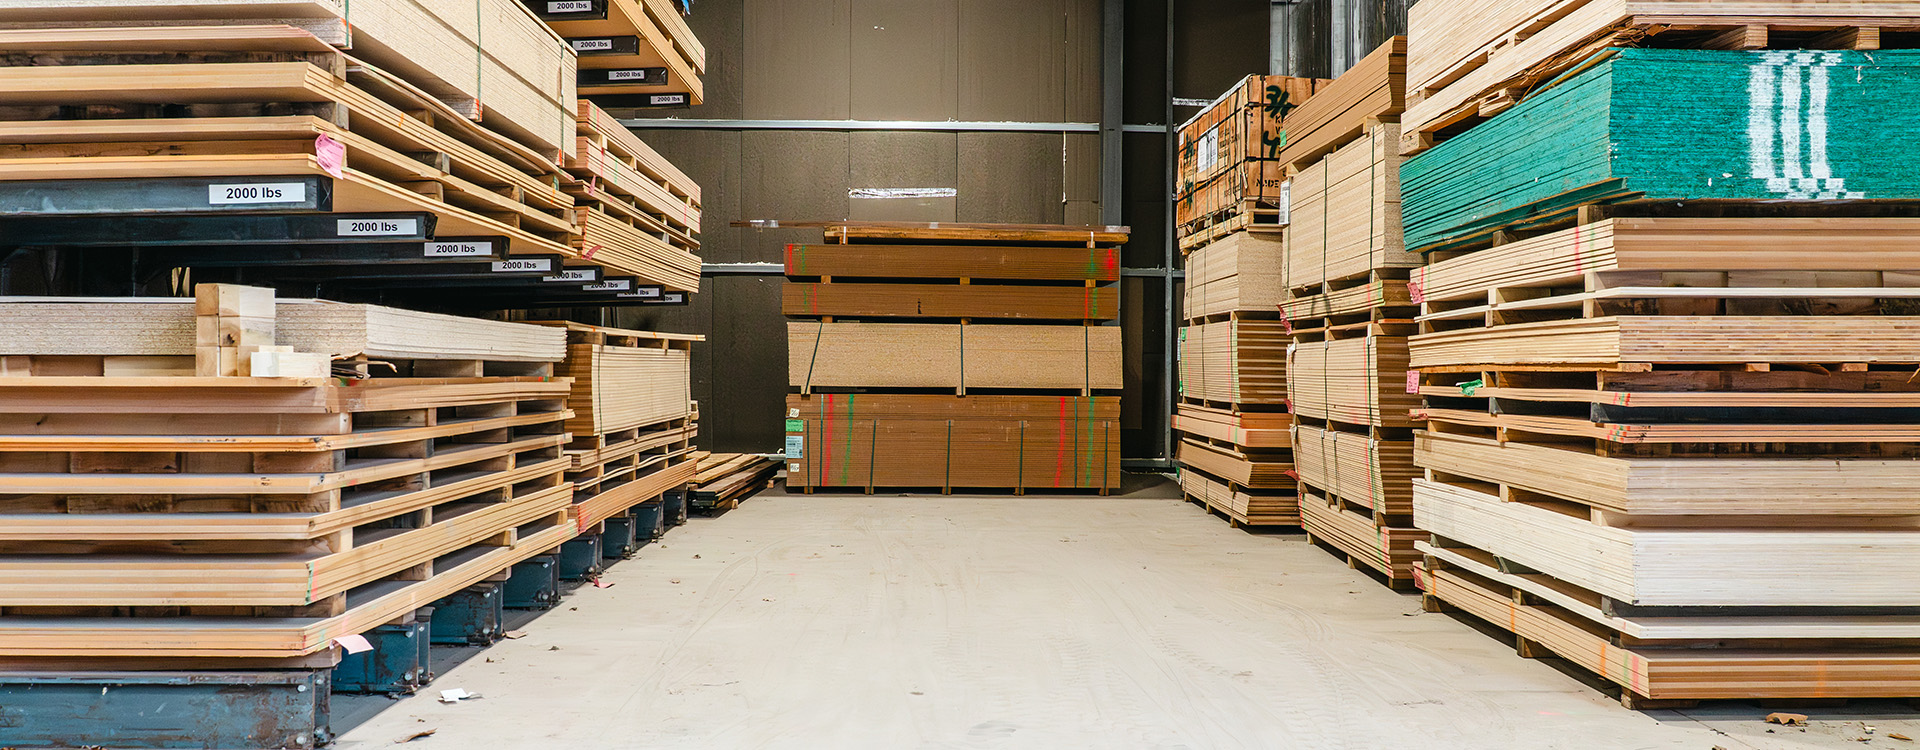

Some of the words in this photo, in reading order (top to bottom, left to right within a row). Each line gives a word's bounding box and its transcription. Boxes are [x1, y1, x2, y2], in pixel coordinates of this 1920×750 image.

[226, 187, 257, 199] 2000
[262, 187, 282, 198] lbs
[351, 222, 378, 232] 2000
[381, 222, 398, 231] lbs
[436, 245, 458, 253] 2000
[502, 261, 521, 269] 2000
